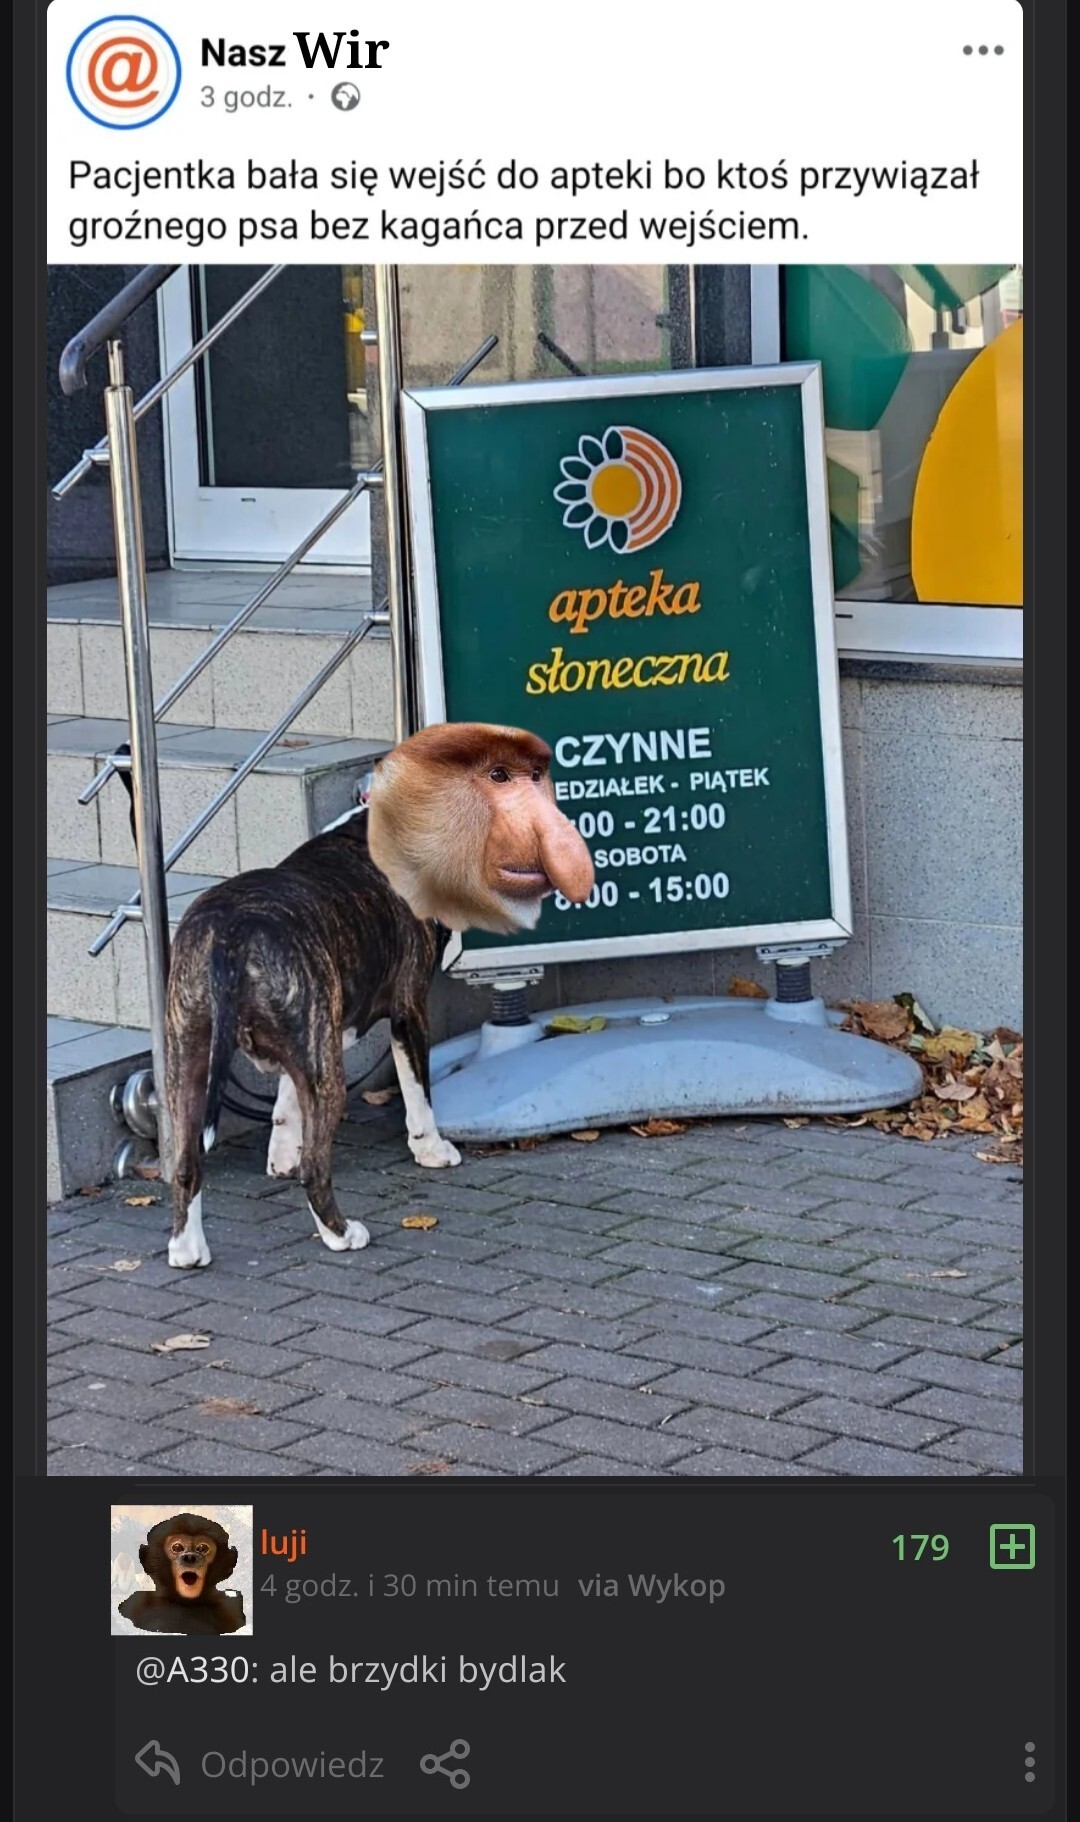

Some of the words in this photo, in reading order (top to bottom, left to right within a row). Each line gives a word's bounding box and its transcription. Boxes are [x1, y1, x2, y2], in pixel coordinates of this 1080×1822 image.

[548, 569, 701, 633] apteka
[527, 648, 730, 694] słoneczna
[555, 727, 712, 767] CZYNNE
[555, 774, 666, 801] EDZIAŁEK
[690, 768, 770, 793] PIĄTEK
[643, 802, 726, 834] 21:00
[594, 844, 687, 868] SOBOTA
[649, 872, 730, 903] 15:00
